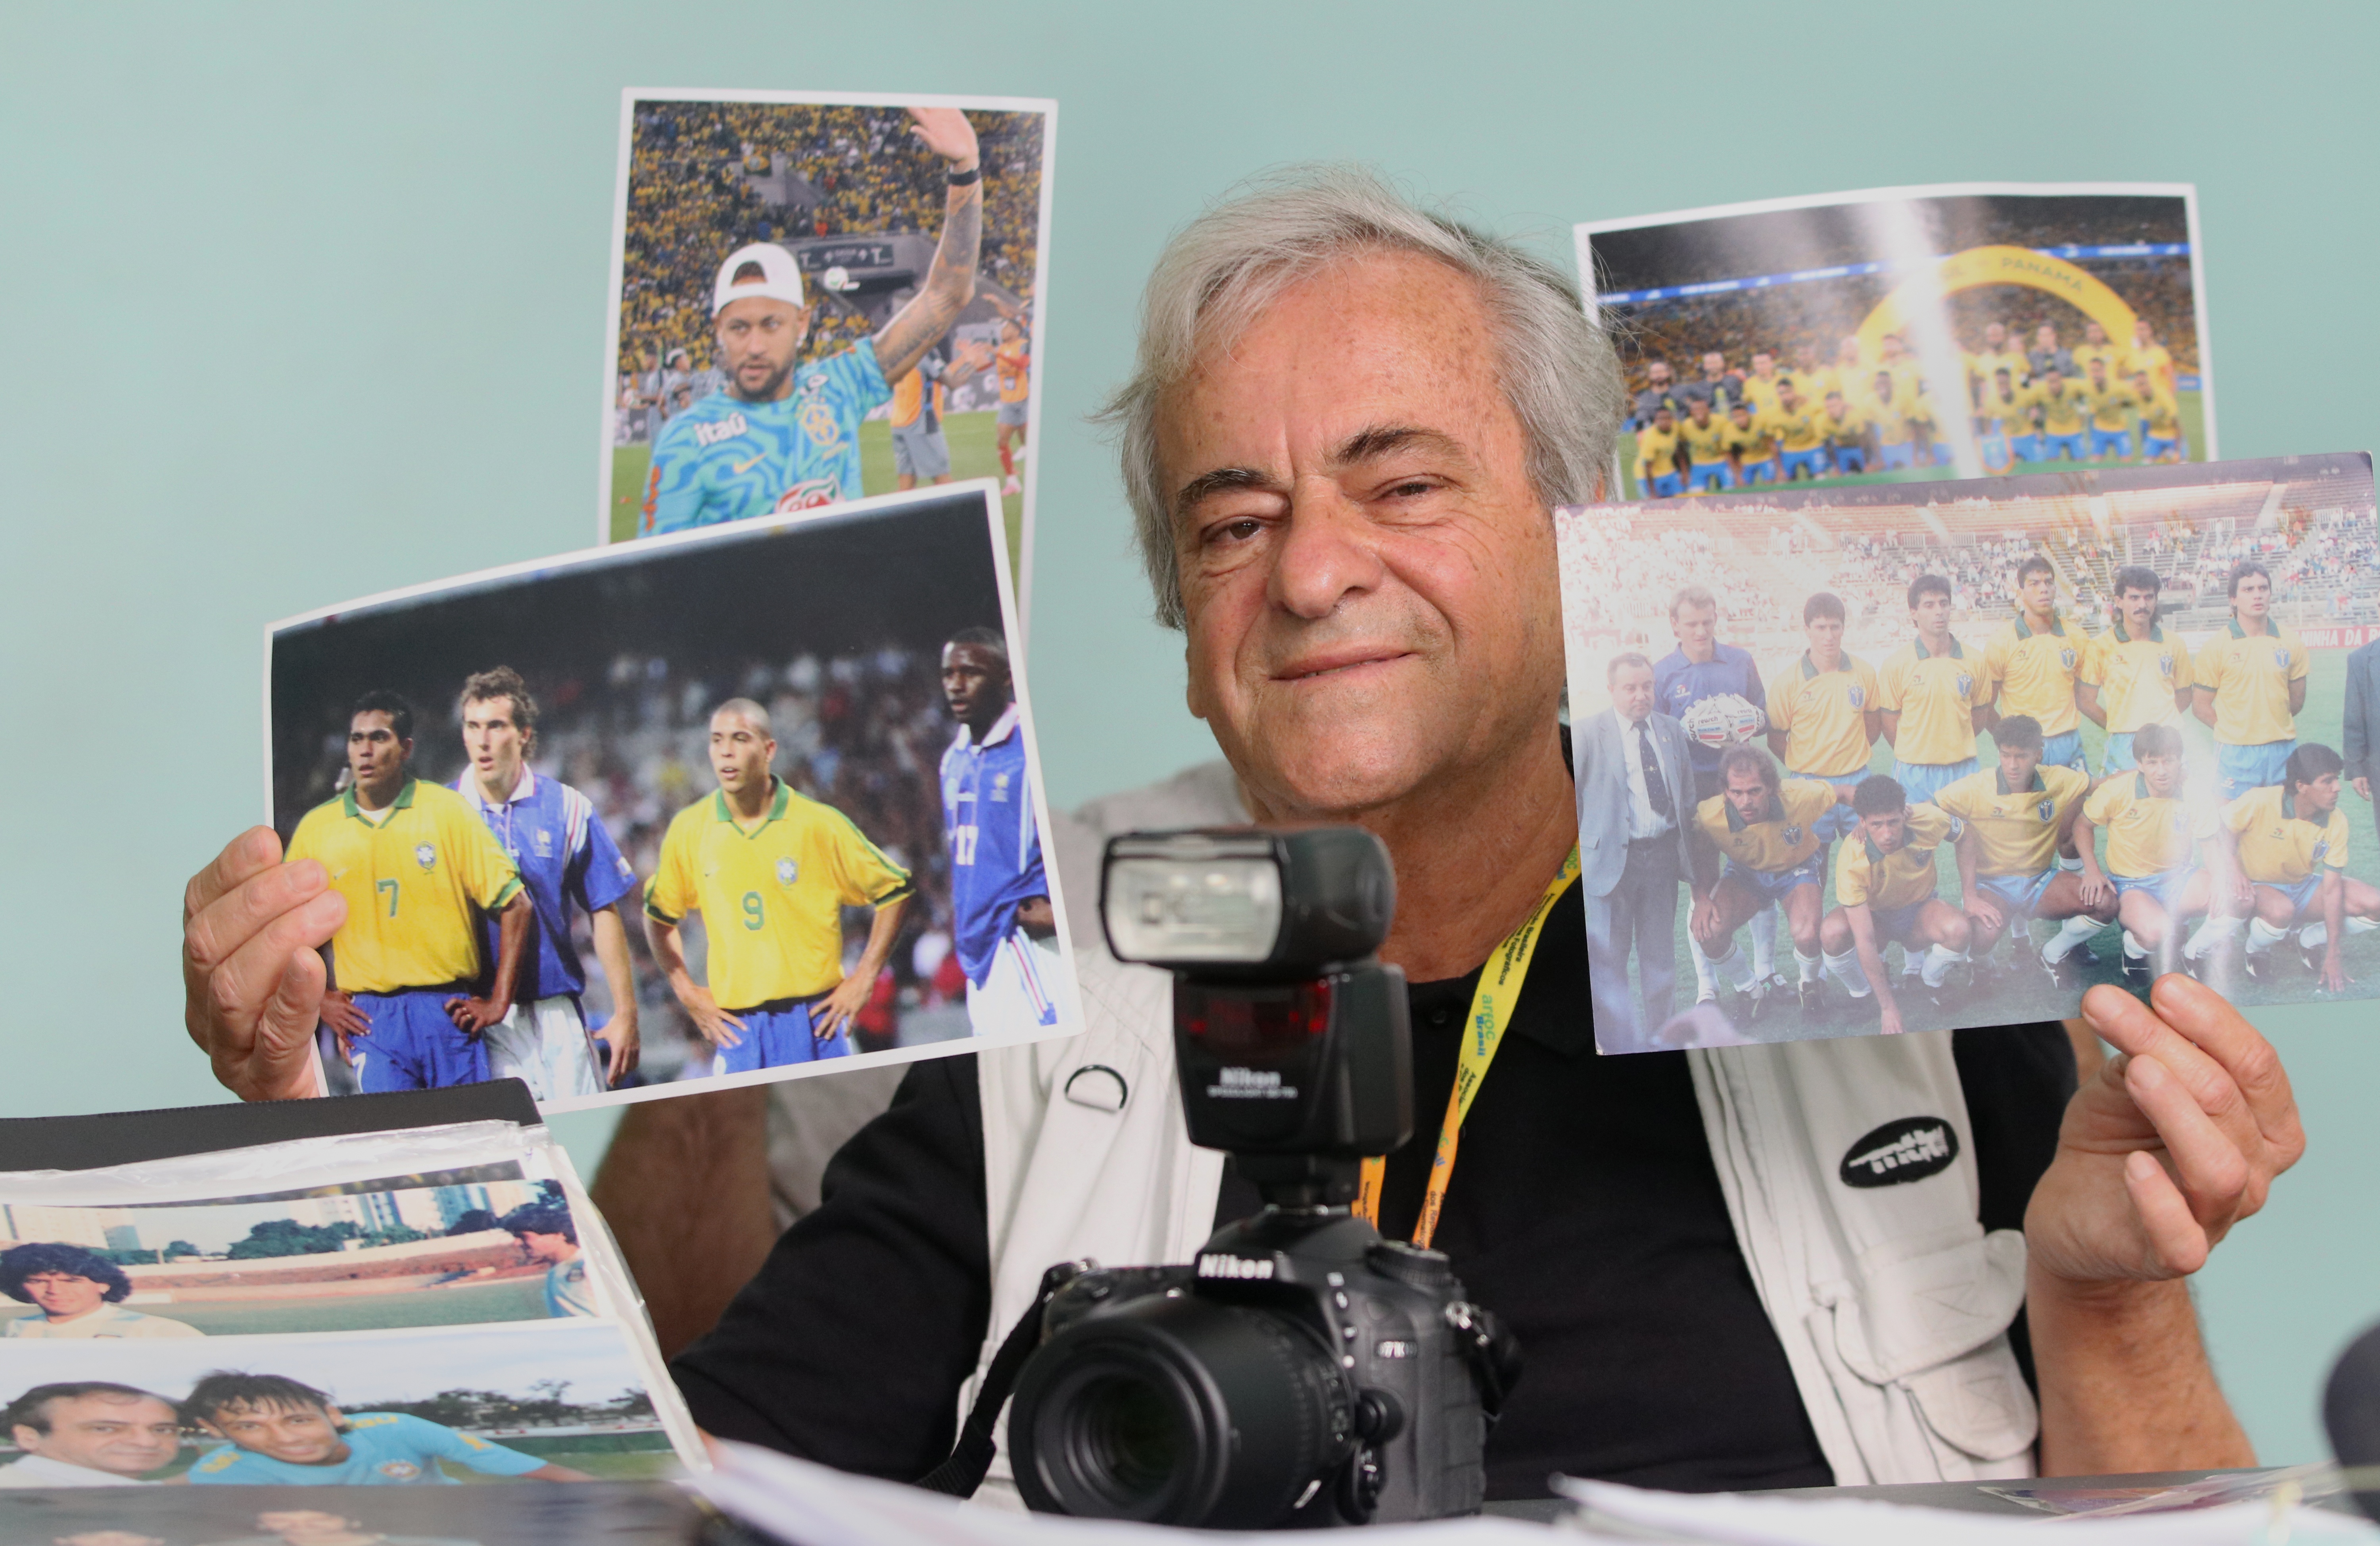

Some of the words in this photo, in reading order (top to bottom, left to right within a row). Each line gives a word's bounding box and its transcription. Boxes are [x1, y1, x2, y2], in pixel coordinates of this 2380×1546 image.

[694, 412, 747, 446] itaú
[2296, 630, 2338, 647] NINHA
[2345, 629, 2362, 646] DA
[2369, 628, 2380, 642] R
[1698, 716, 1718, 724] reusch
[956, 825, 979, 866] 17
[377, 879, 399, 918] 7
[743, 891, 765, 931] 9
[1482, 994, 1495, 1041] arfoc
[1476, 1016, 1486, 1056] Brasil
[1219, 1066, 1281, 1086] Nikon
[1198, 1253, 1274, 1279] Nikon
